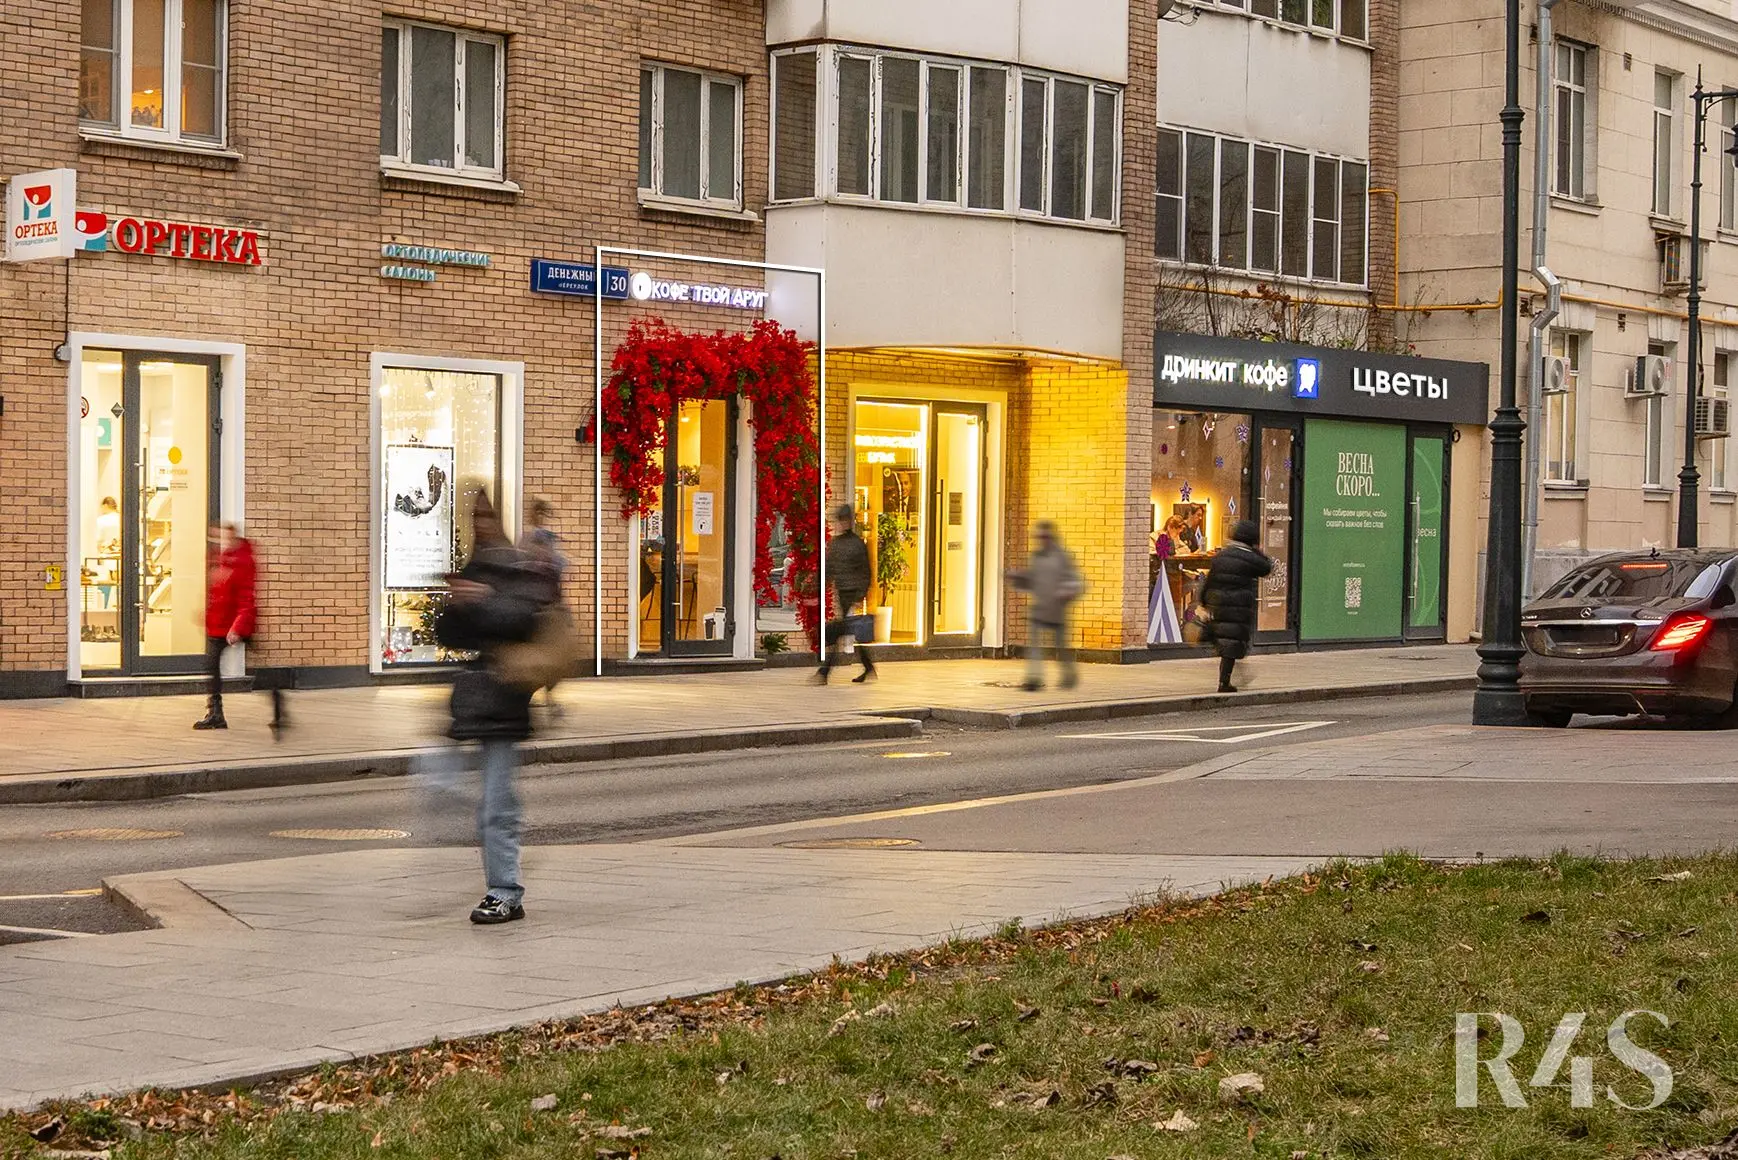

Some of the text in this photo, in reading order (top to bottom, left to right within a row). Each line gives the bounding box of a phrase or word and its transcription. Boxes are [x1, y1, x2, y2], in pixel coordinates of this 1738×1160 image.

[115, 217, 262, 266] ОРТЕКА
[547, 266, 598, 282] ДЕНЕЖНЫ
[610, 276, 627, 292] 30
[651, 280, 769, 308] КОФЕ ТВОЙ ДРУГ
[1243, 359, 1288, 392] кофе
[1353, 366, 1448, 400] цветы
[1338, 452, 1374, 475] ВЕСНА
[1336, 474, 1380, 497] СКОРО...
